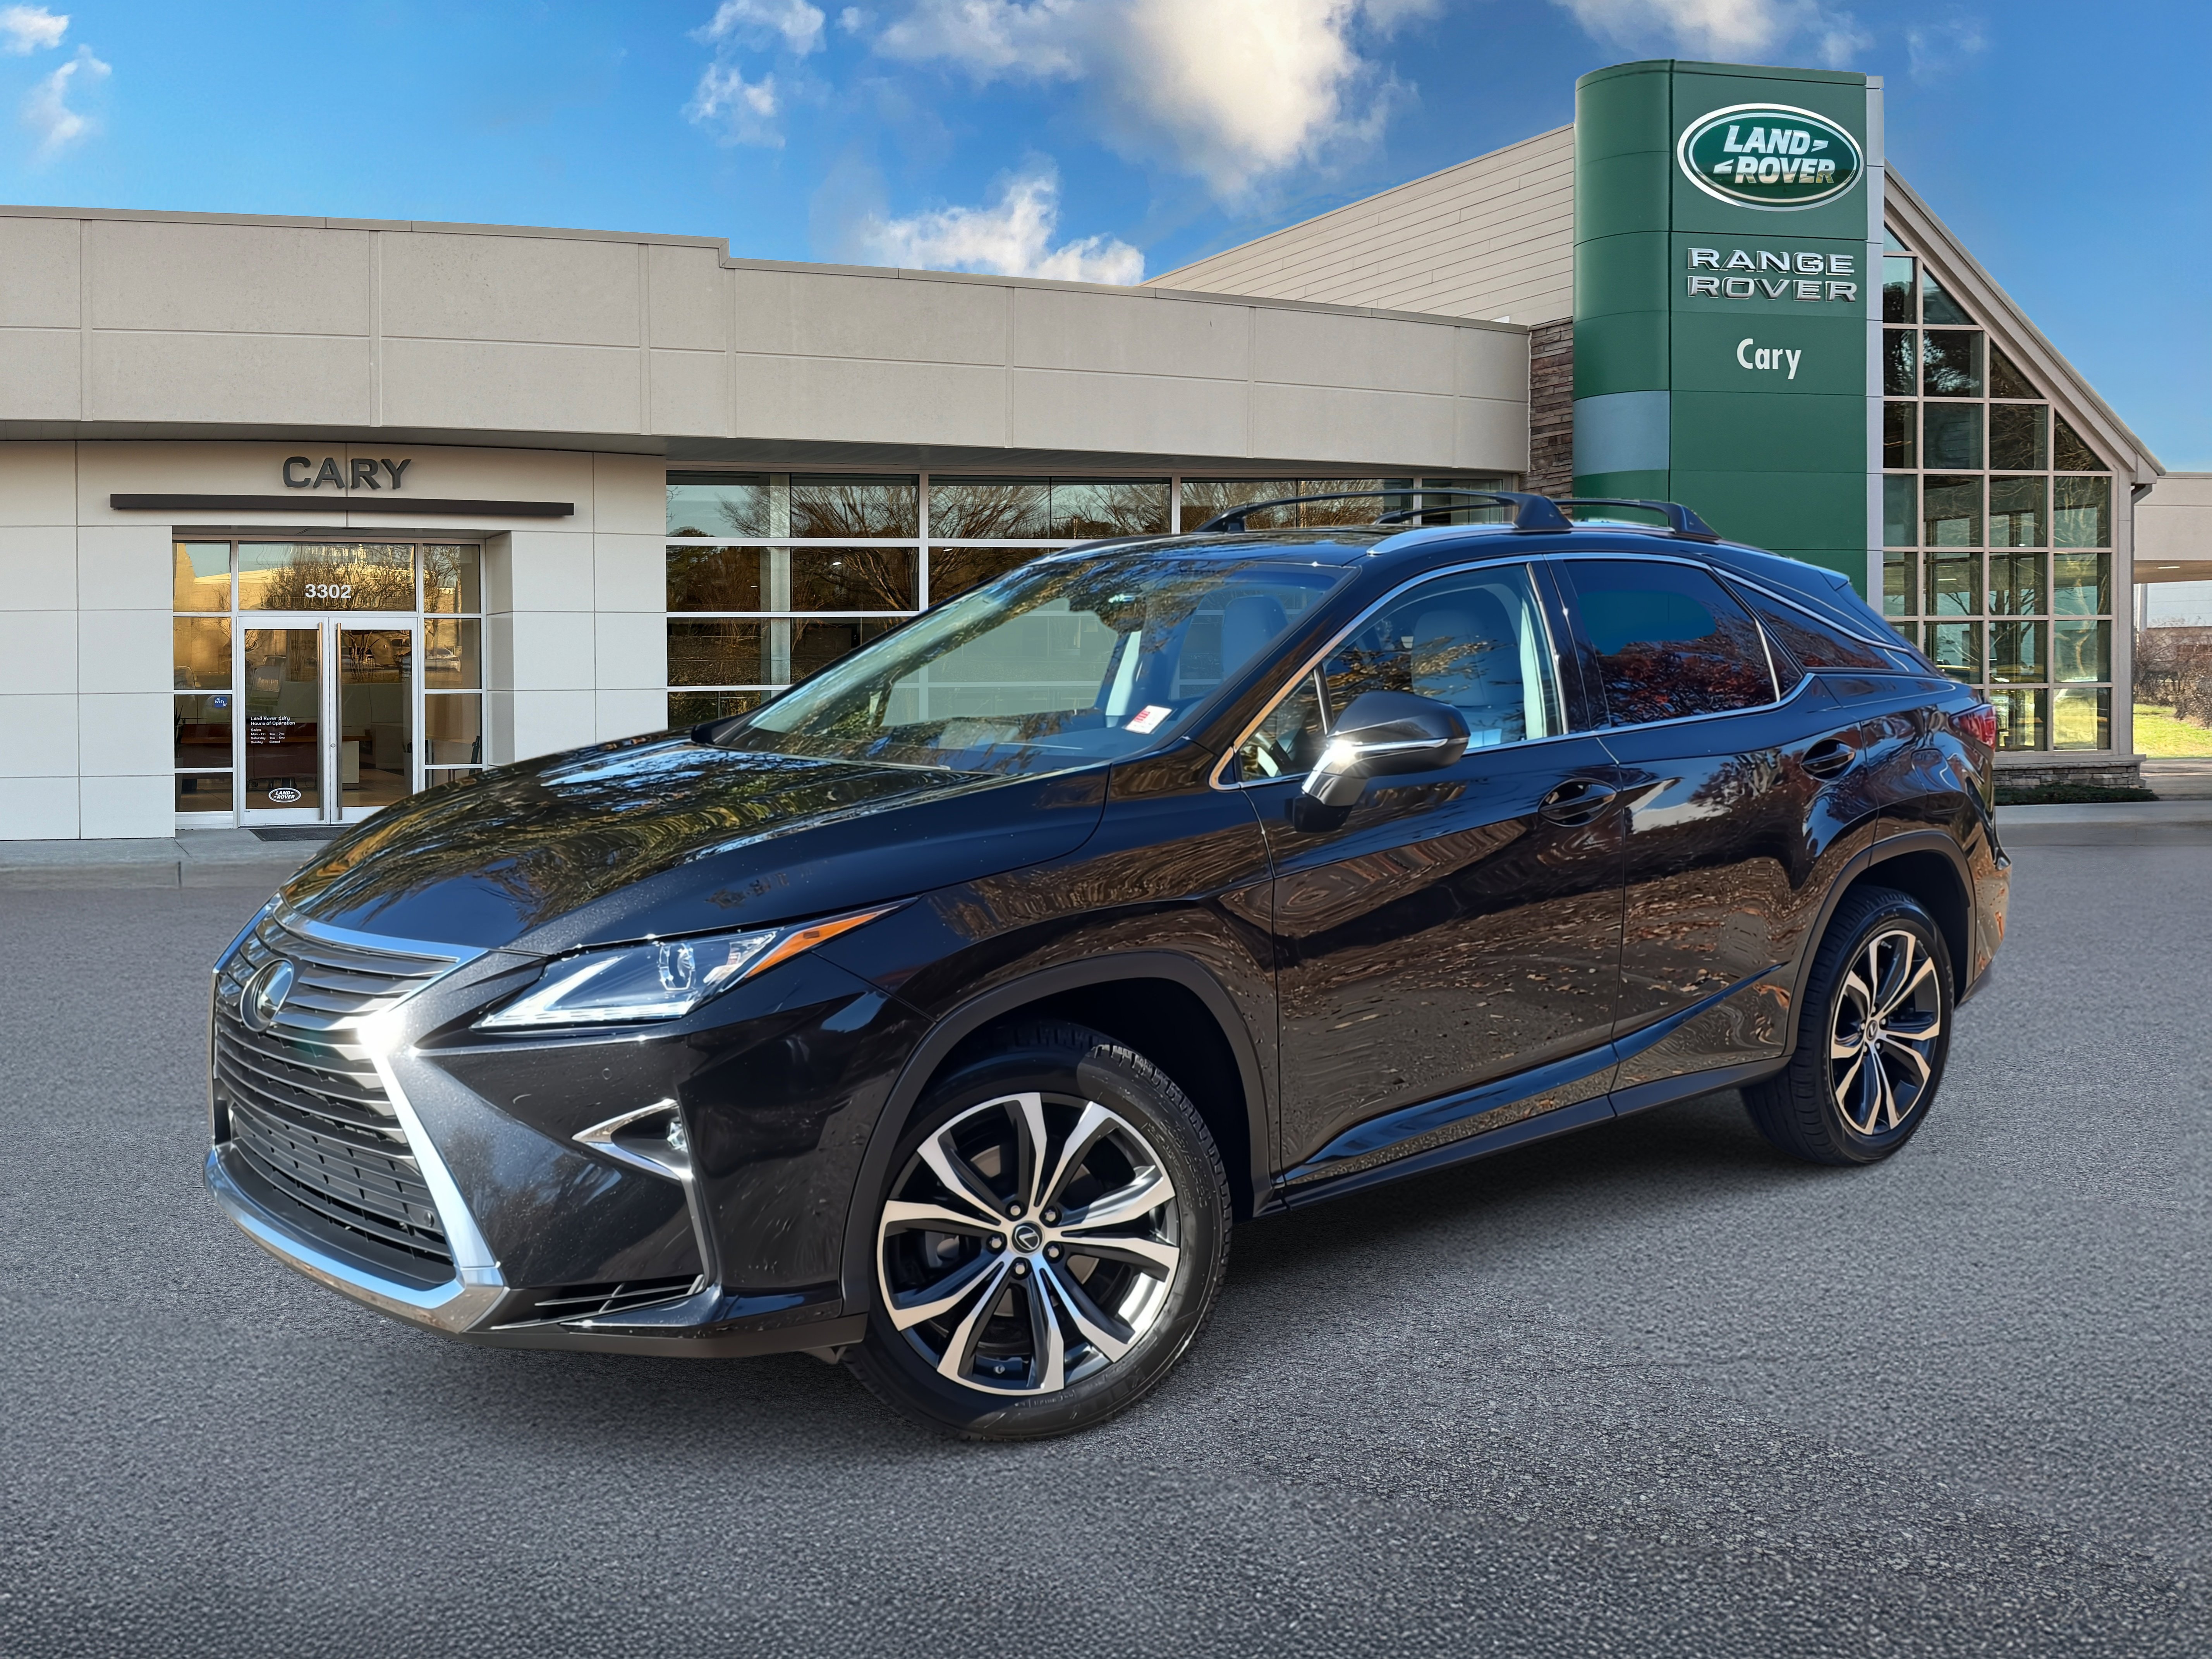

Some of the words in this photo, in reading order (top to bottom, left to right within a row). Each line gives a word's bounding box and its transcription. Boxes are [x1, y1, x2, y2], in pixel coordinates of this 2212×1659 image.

[1724, 125, 1810, 154] LAND
[1735, 156, 1835, 184] ROVER
[1688, 248, 1855, 275] RANGE
[1688, 275, 1857, 302] ROVER
[1736, 338, 1802, 380] Cary
[283, 457, 411, 489] CARY
[305, 584, 351, 598] 3302
